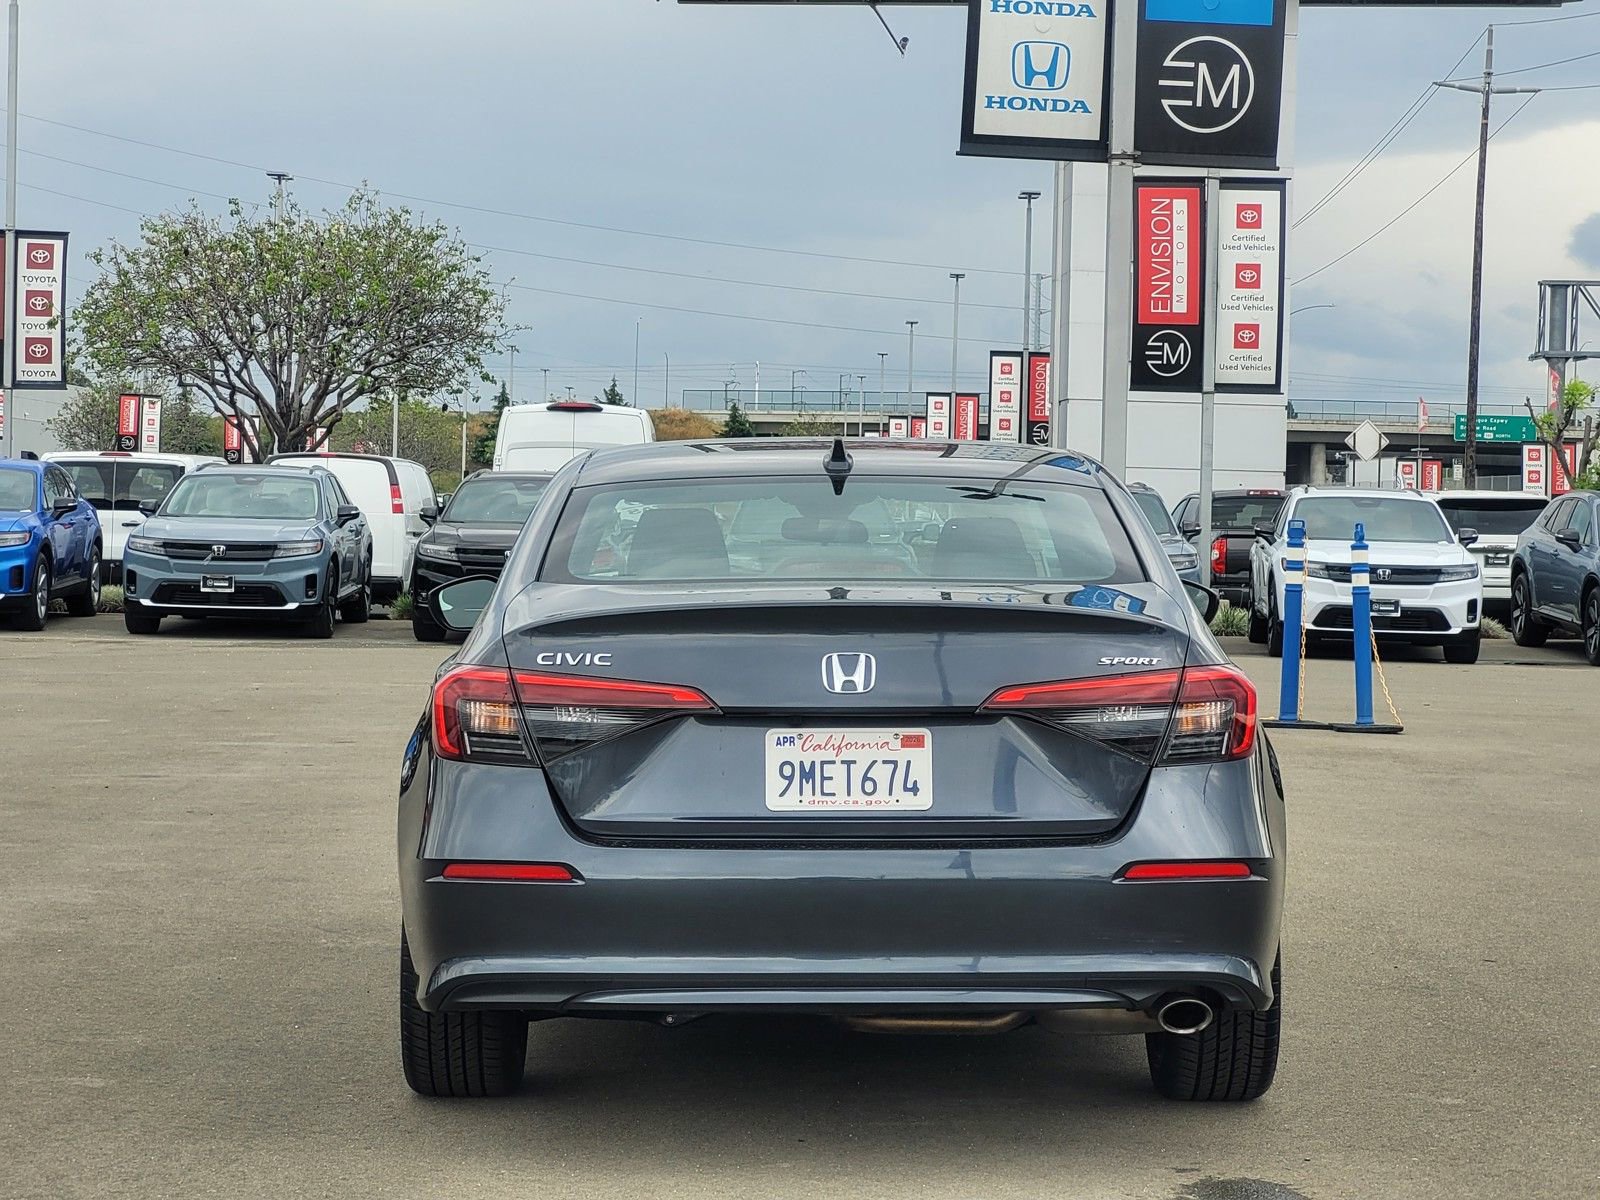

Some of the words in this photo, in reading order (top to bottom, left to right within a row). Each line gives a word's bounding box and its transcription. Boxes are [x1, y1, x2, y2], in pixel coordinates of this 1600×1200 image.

[989, 0, 1097, 18] HONDA
[983, 95, 1093, 115] HONDA
[1231, 234, 1266, 242] Certified
[1221, 243, 1242, 251] Used
[1244, 243, 1276, 251] Vehicles
[1150, 197, 1172, 313] ENVISION
[1175, 208, 1185, 304] MOTORS
[22, 275, 58, 283] TOYOTA
[1230, 294, 1265, 302] Certified
[1220, 303, 1240, 311] Used
[1242, 303, 1274, 312] Vehicles
[21, 322, 56, 331] TOYO
[1228, 354, 1263, 362] Certified
[1219, 363, 1239, 371] Used
[1240, 363, 1272, 372] Vehicles
[20, 369, 57, 378] TOYOTA
[1034, 361, 1046, 417] ENVISION
[536, 652, 613, 666] CIVIC
[1097, 656, 1162, 665] SPORT
[775, 736, 796, 747] APR
[800, 733, 902, 758] California
[778, 759, 920, 798] 9MET674
[807, 798, 892, 806] dmv.ca.gov
